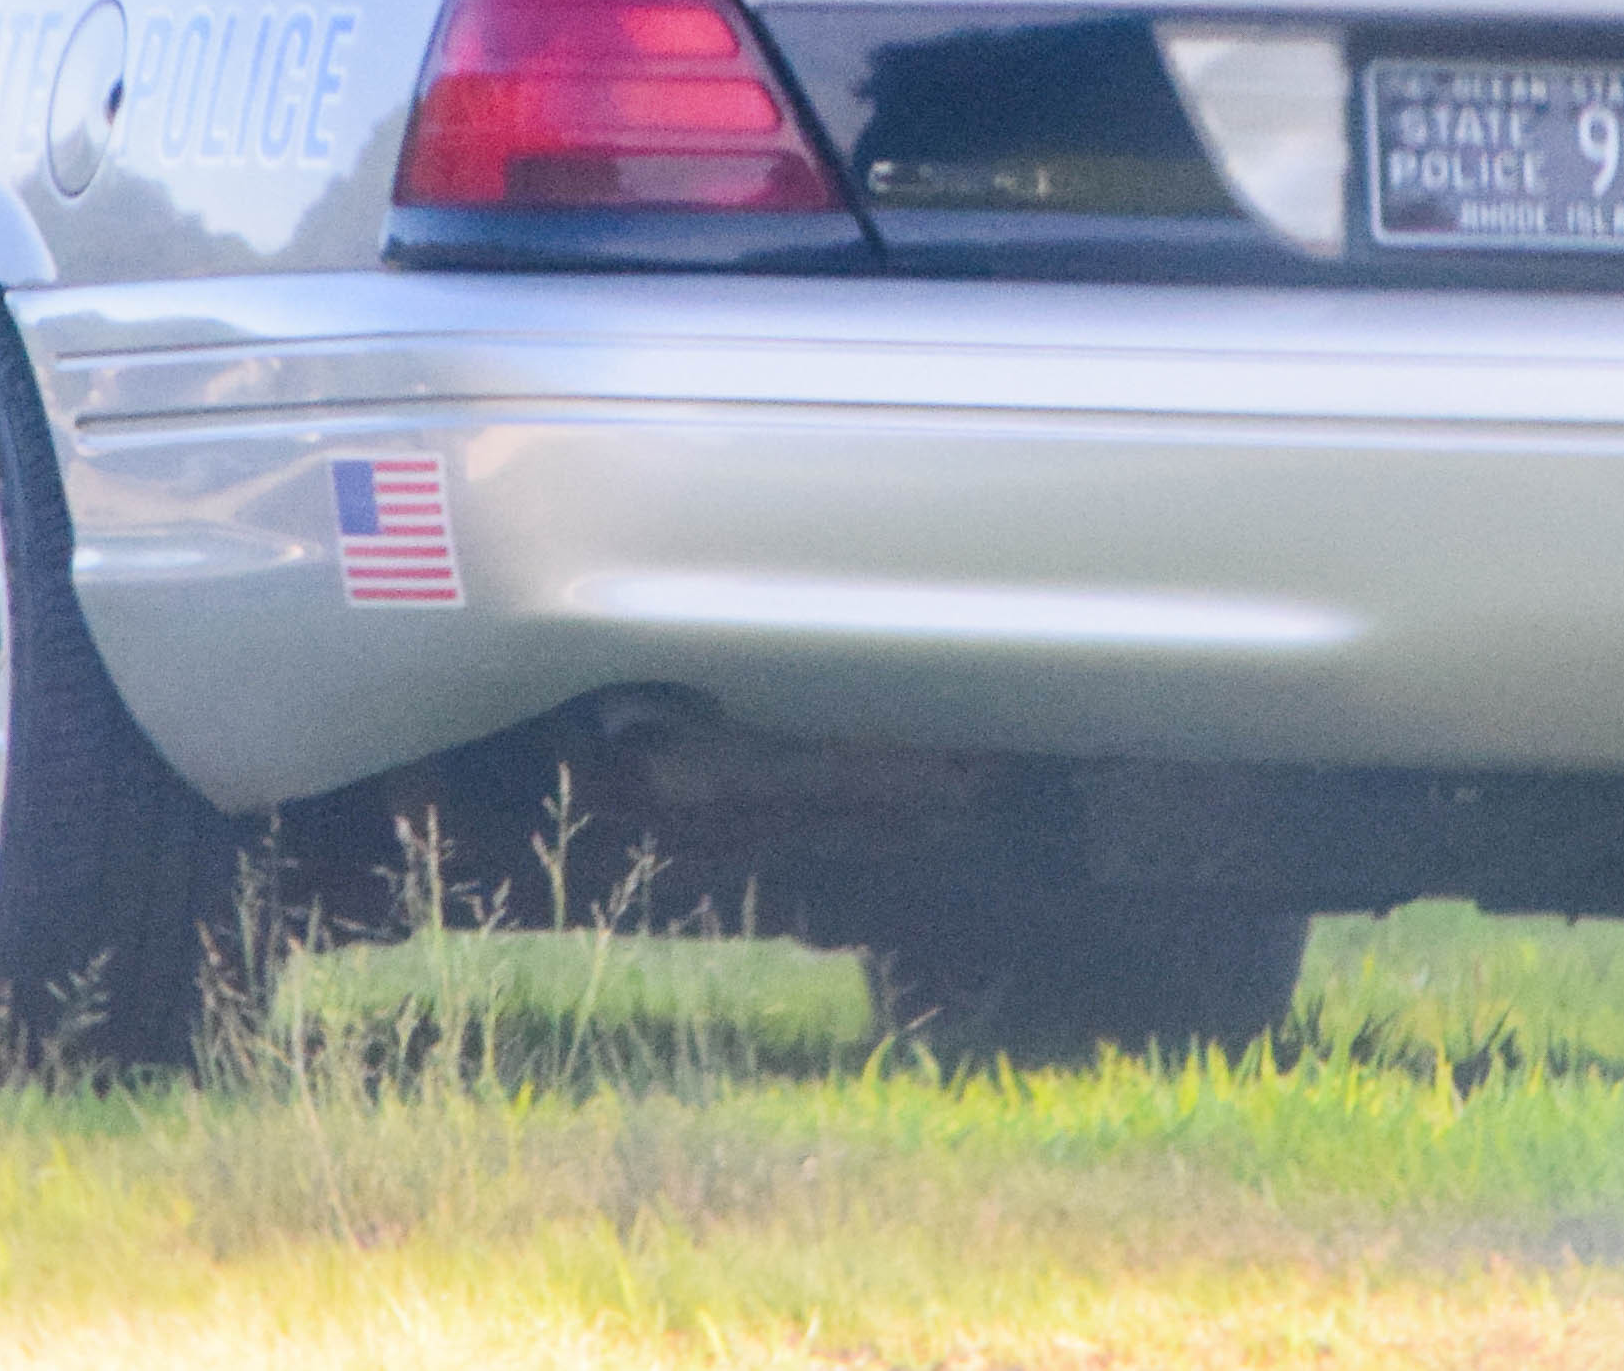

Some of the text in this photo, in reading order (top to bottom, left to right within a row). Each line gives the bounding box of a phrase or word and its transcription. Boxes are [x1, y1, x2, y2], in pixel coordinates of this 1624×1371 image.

[116, 9, 358, 162] POLICE
[1399, 105, 1528, 147] STATE
[1388, 149, 1544, 194] POLICE
